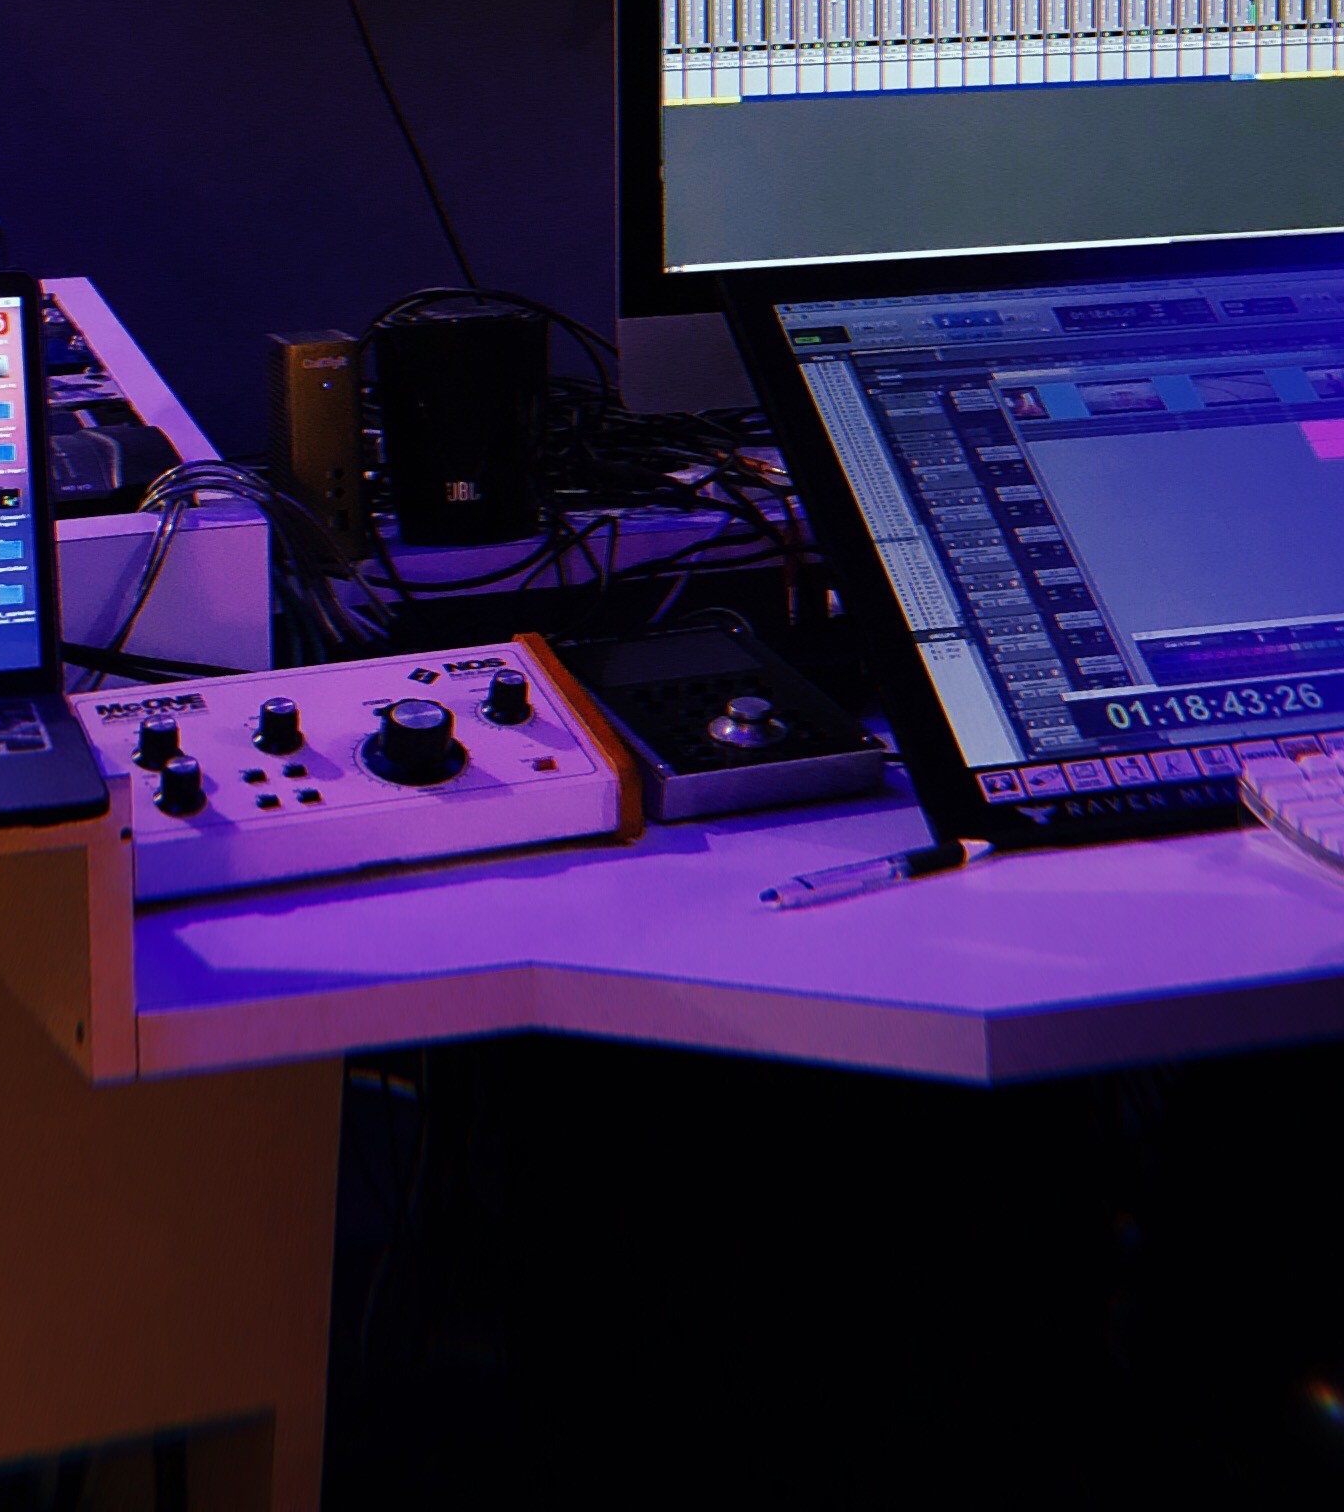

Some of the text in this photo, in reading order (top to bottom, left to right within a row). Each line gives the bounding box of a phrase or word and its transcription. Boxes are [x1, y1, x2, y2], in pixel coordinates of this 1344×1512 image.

[446, 481, 482, 502] JBL
[1107, 682, 1324, 730] 01:18:43;26
[1064, 791, 1169, 818] RAVEN
